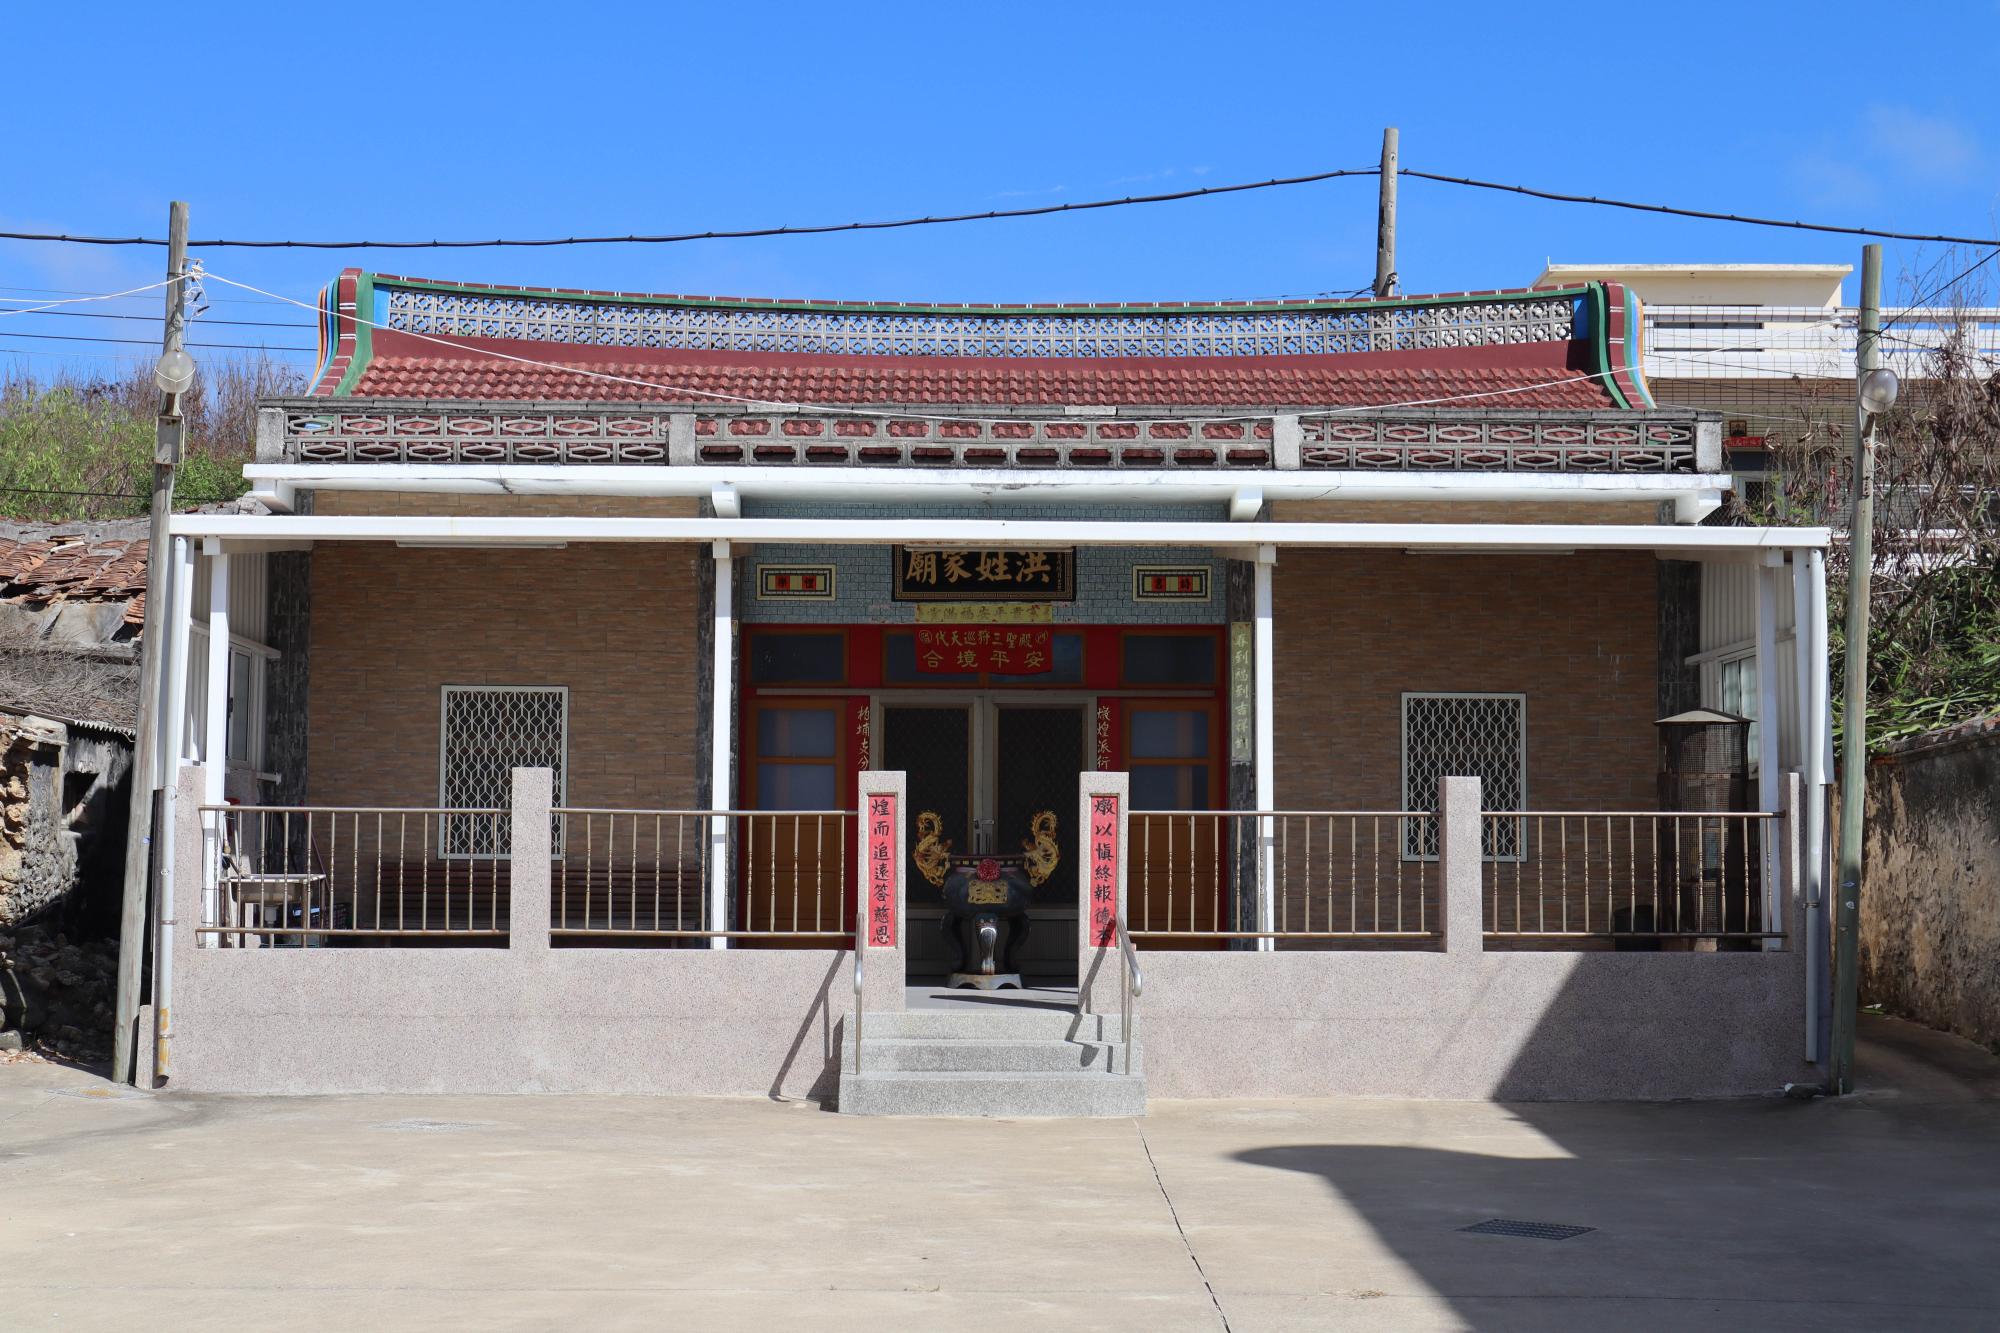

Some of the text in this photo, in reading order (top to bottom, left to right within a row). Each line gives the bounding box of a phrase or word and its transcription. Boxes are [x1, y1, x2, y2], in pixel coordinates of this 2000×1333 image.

[905, 551, 1051, 585] 洪姓家廟
[922, 650, 1045, 668] 合境平安
